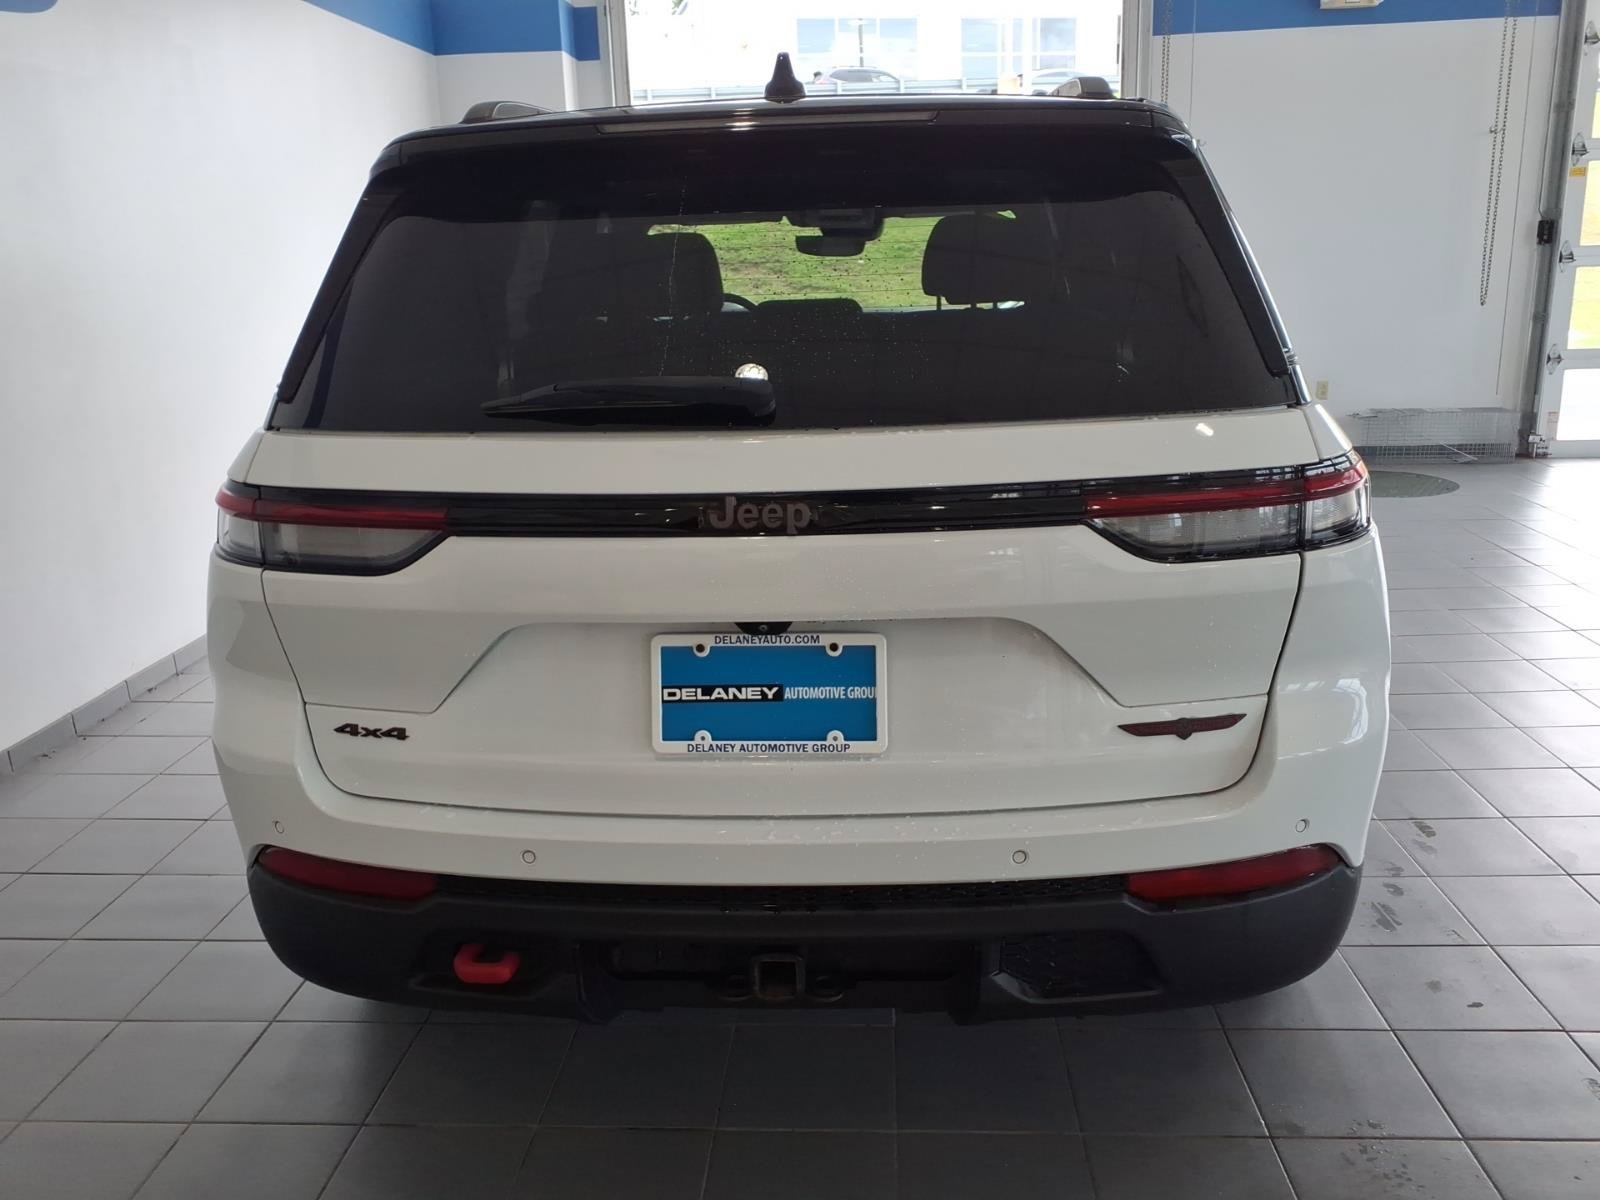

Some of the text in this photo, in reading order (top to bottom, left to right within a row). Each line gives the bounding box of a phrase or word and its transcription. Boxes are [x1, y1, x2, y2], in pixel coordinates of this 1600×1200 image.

[707, 495, 812, 535] Jeep
[714, 634, 821, 645] DELANEYAUTO.COM
[663, 686, 779, 701] DELANEY
[784, 686, 846, 700] AUTOMOTIVE
[687, 743, 851, 753] DELANEY AUTOMOTIVE GROUP
